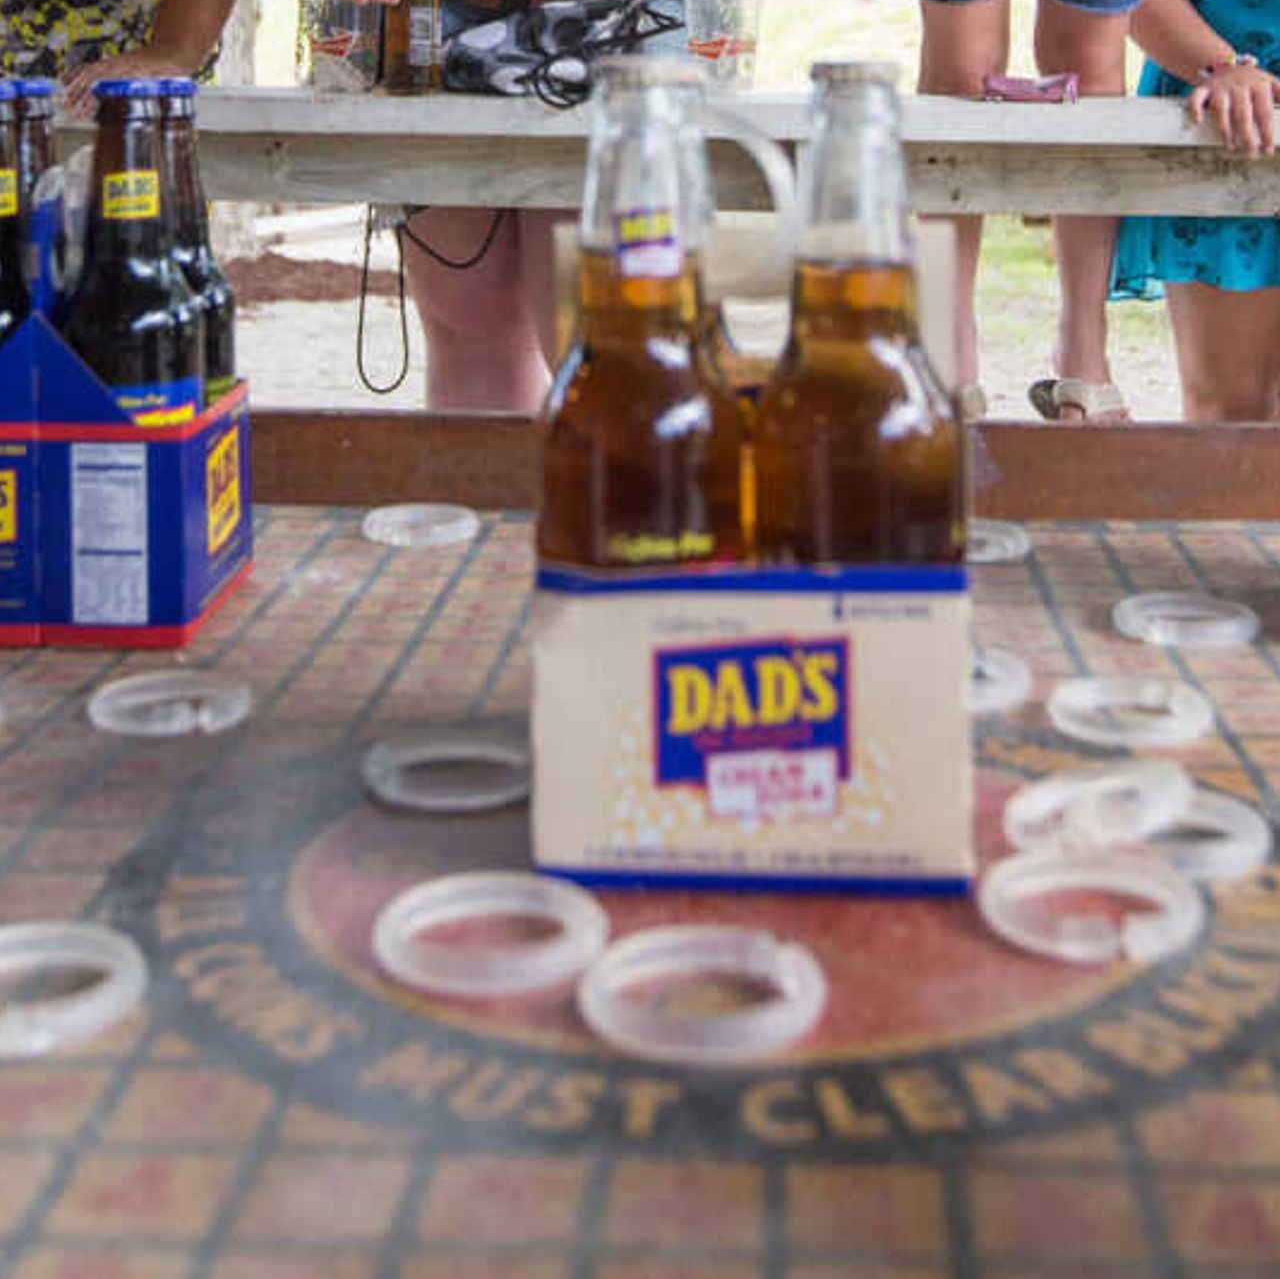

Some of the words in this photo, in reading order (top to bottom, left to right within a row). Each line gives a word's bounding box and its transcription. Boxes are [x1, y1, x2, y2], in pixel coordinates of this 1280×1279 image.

[665, 649, 839, 735] DAD'S
[358, 1043, 681, 1137] MUST
[740, 1047, 1112, 1144] CLEAR
